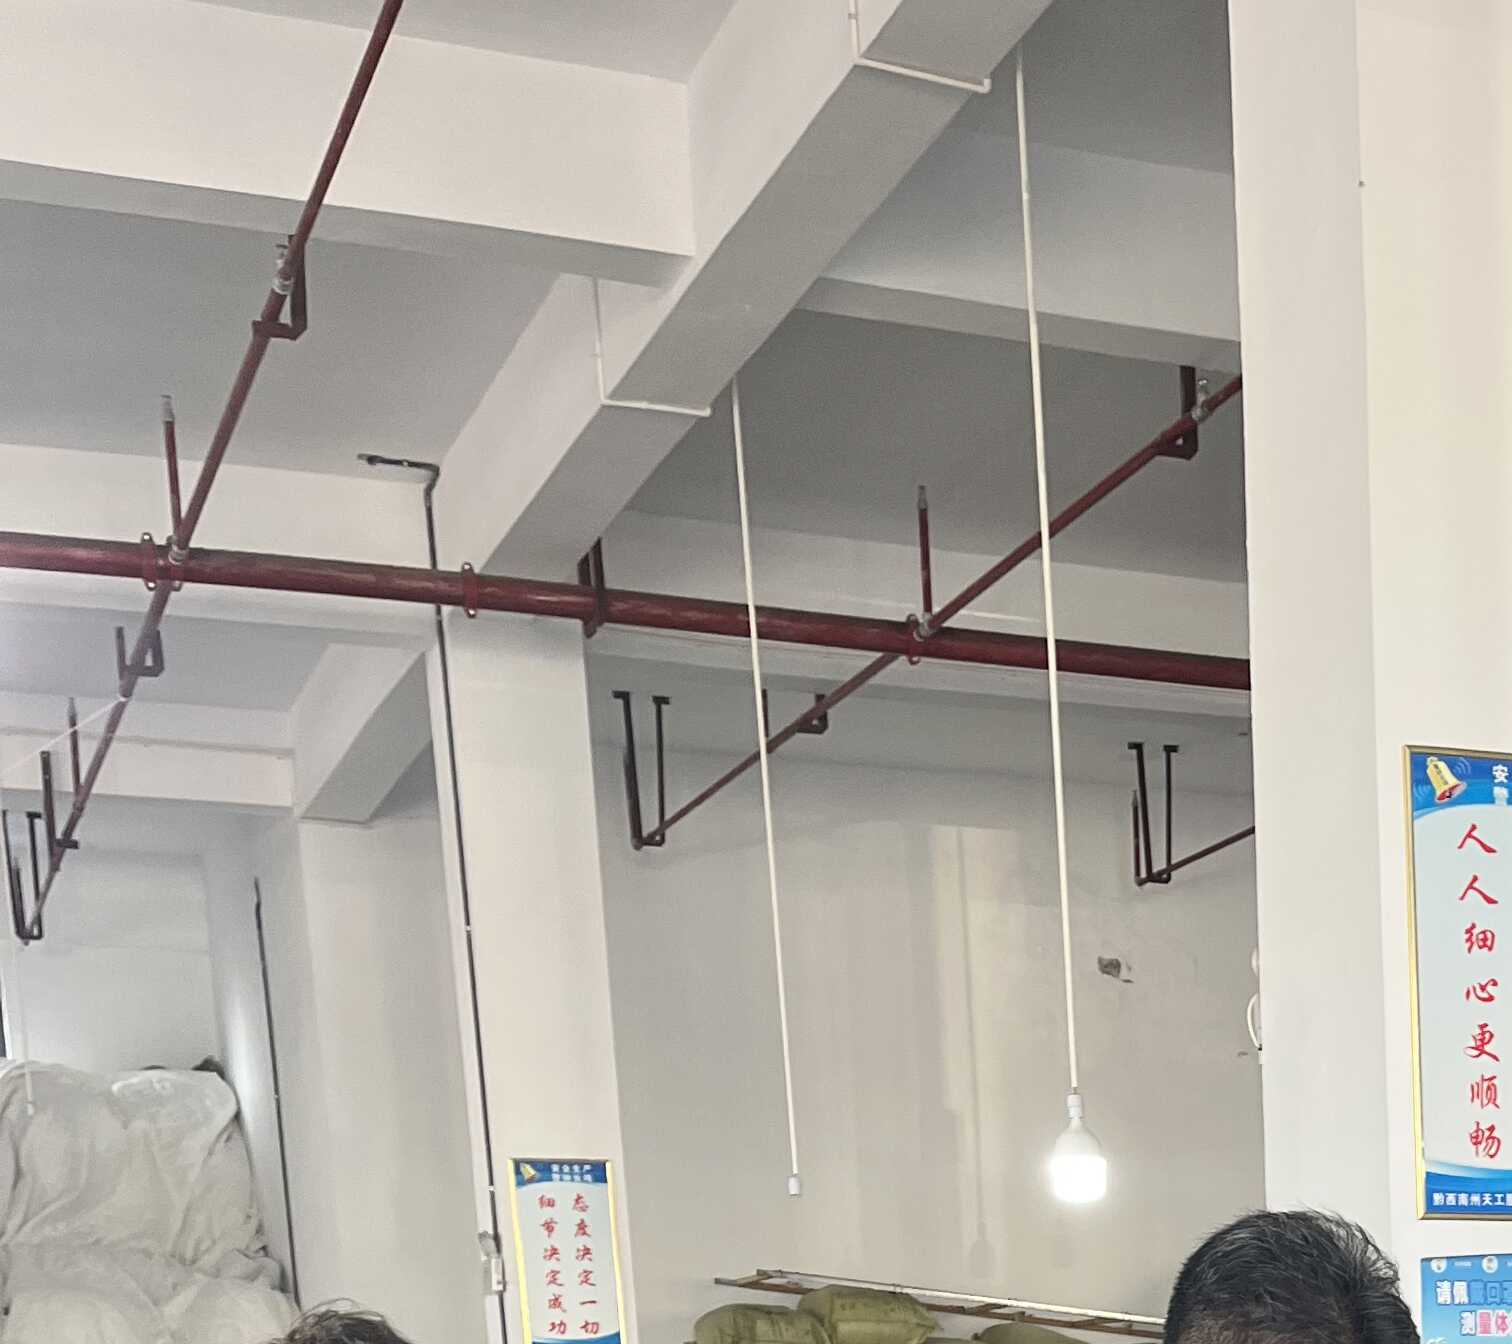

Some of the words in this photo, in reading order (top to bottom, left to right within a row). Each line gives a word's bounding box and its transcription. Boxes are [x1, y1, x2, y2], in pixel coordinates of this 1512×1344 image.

[1457, 823, 1502, 1161] 人人细心更顺畅
[537, 1193, 568, 1335] 细节决定成功
[572, 1193, 600, 1335] 态度决定一切
